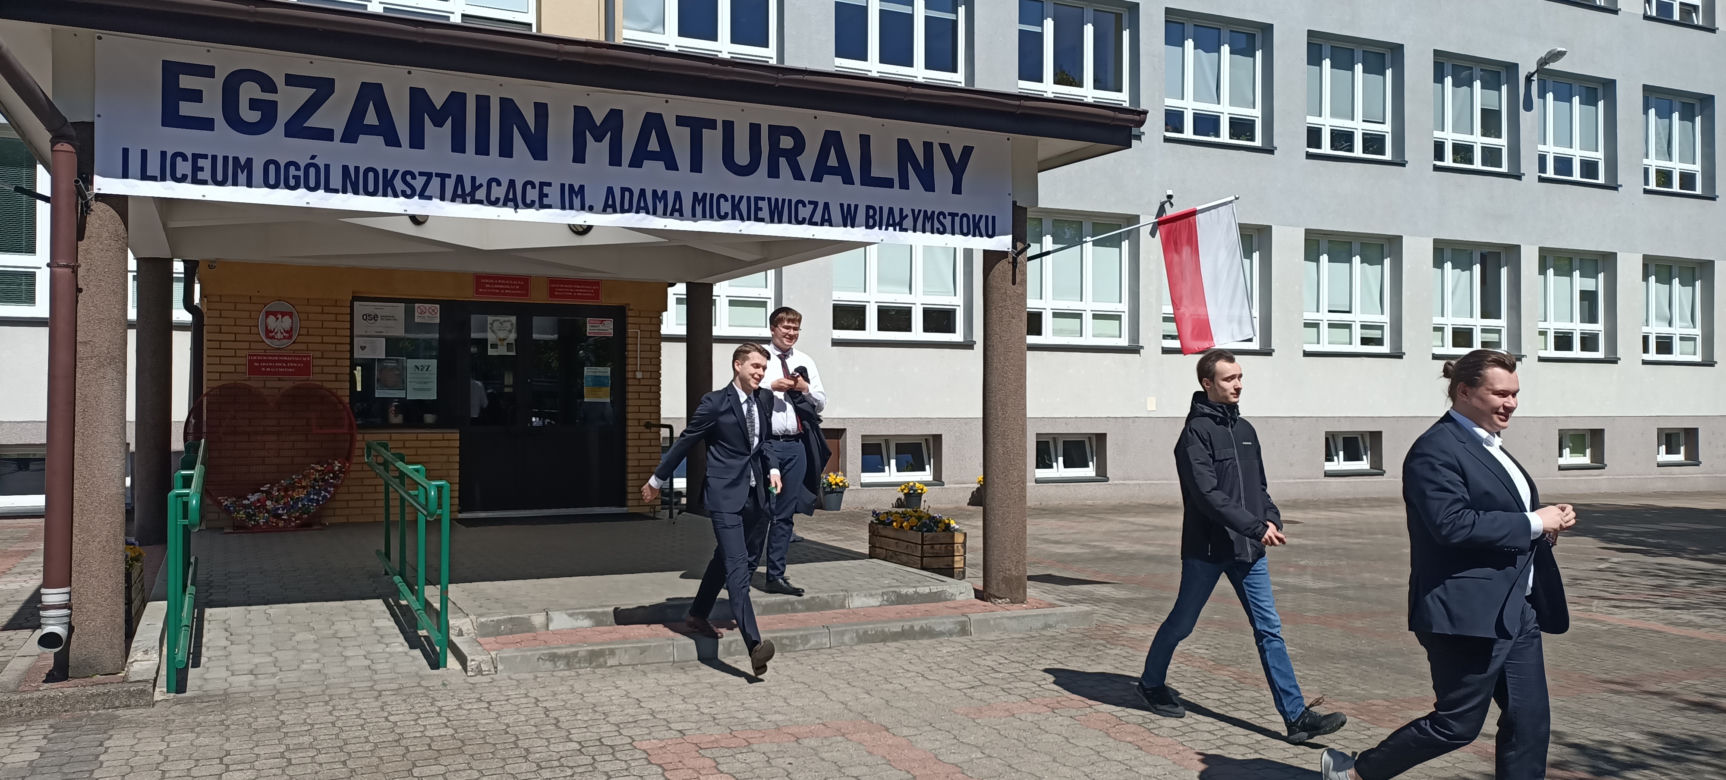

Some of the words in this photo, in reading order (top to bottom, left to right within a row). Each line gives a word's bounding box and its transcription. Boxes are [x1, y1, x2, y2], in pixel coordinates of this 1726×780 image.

[160, 59, 549, 162] EGZAMIN
[571, 104, 976, 196] MATURALNY
[121, 146, 130, 180] I
[139, 148, 254, 189] LICEUM
[262, 154, 553, 211] OGÓLNOKSZTAŁCĄCE
[559, 182, 595, 212] IM.
[601, 185, 685, 218] ADAMA
[690, 191, 834, 228] MICKIEWICZA
[838, 202, 860, 229] W
[864, 204, 997, 239] BIAŁYMSTOKU
